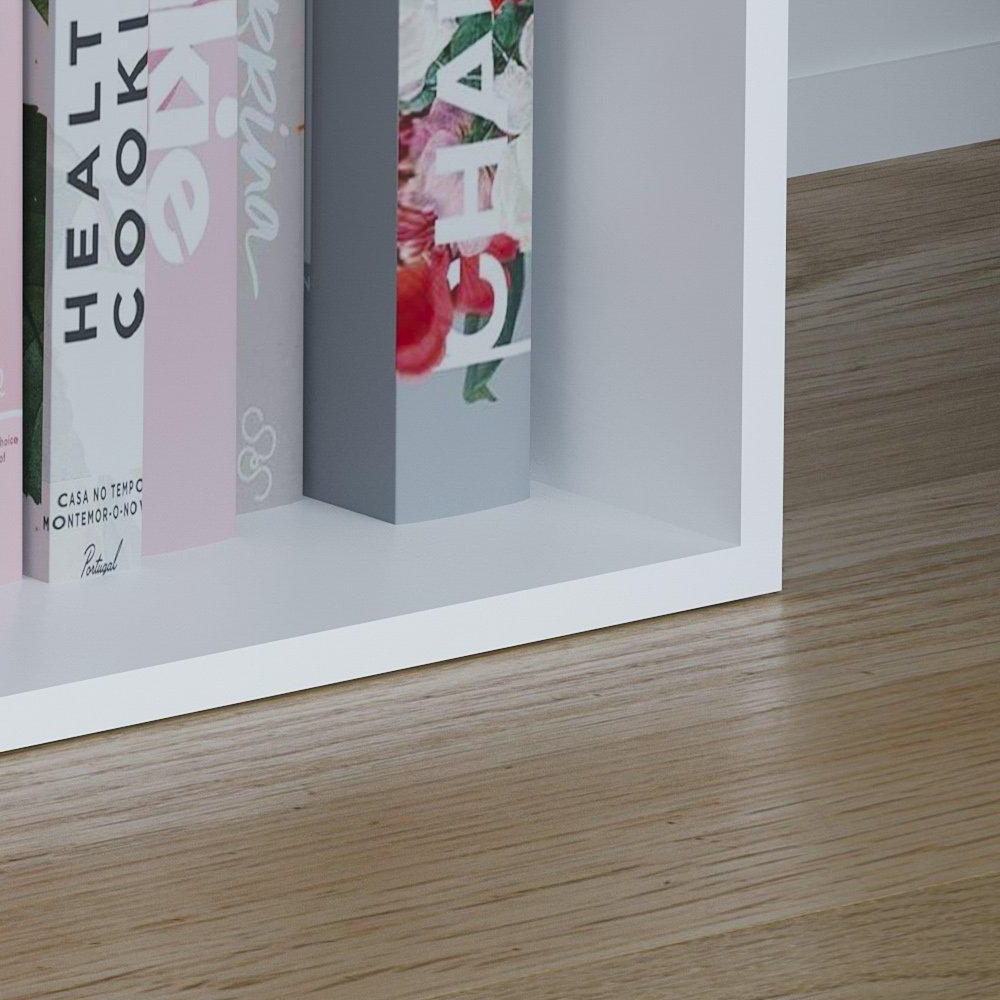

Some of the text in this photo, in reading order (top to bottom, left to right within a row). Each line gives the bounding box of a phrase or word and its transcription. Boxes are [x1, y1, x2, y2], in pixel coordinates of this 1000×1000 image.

[0, 452, 6, 463] of
[58, 490, 89, 508] CASA
[93, 486, 107, 502] NO
[81, 538, 123, 578] Portugal
